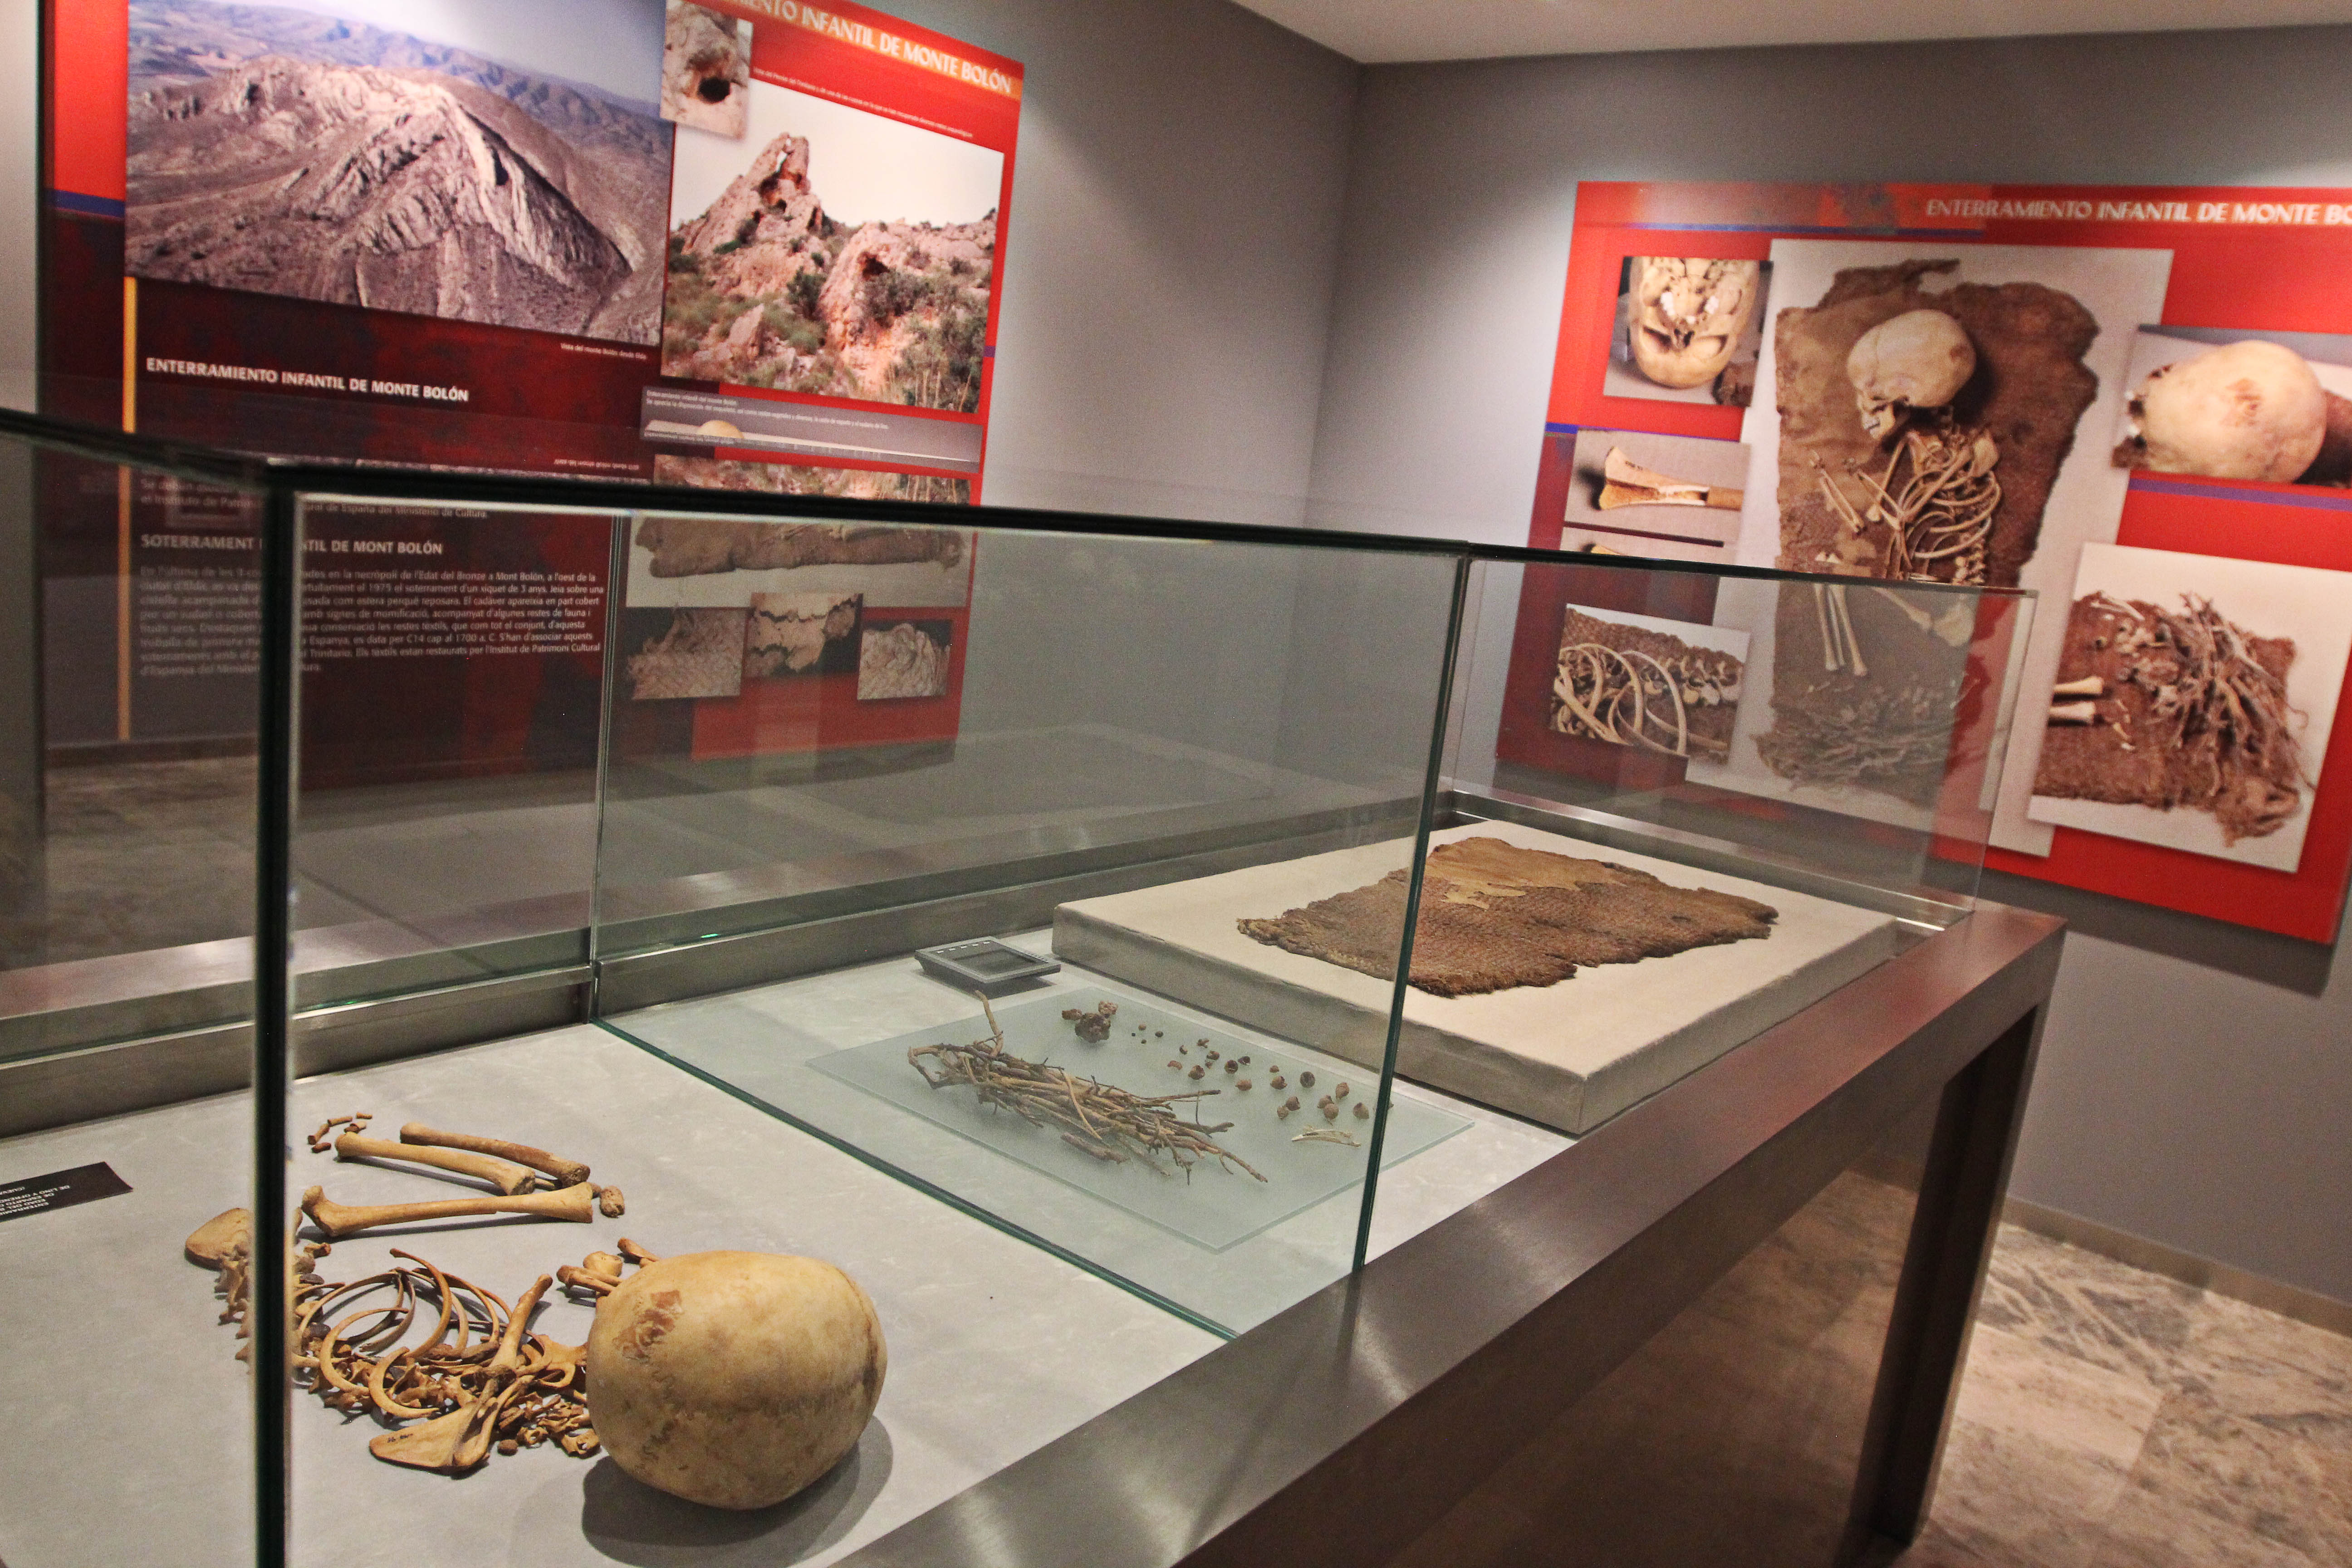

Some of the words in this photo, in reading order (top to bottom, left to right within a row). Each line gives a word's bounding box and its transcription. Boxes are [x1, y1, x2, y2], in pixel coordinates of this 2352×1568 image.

[802, 6, 876, 49] INFANTIL
[879, 32, 901, 56] DE
[903, 40, 959, 76] MONTE
[961, 61, 1011, 93] BOLÓN
[1926, 198, 2092, 219] ENTERRAMIENTO
[2097, 201, 2192, 222] INFANTIL
[2196, 202, 2229, 223] DE
[2232, 203, 2320, 225] MONTE
[146, 357, 279, 383] ENTERRAMIENTO
[282, 371, 346, 391] INFANTIL
[348, 378, 368, 392] DE
[371, 380, 420, 398] MONTE
[422, 386, 469, 402] BOLÓN
[141, 534, 254, 550] SOTERRAMENT
[331, 540, 349, 553] DE
[353, 540, 394, 554] MONT
[397, 540, 443, 554] BOLÓN
[440, 570, 455, 580] del
[495, 572, 518, 580] Mont
[576, 573, 588, 582] de
[588, 573, 596, 582] la
[507, 584, 519, 593] de
[566, 584, 588, 594] sobre
[545, 598, 556, 606] en
[557, 598, 573, 607] part
[574, 596, 599, 606] cobert
[552, 608, 563, 617] de
[564, 608, 586, 617] fauna
[426, 634, 442, 644] cap
[444, 633, 453, 642] al
[519, 644, 530, 654] de
[531, 643, 569, 653] Patrimoni
[571, 642, 601, 652] Cultural
